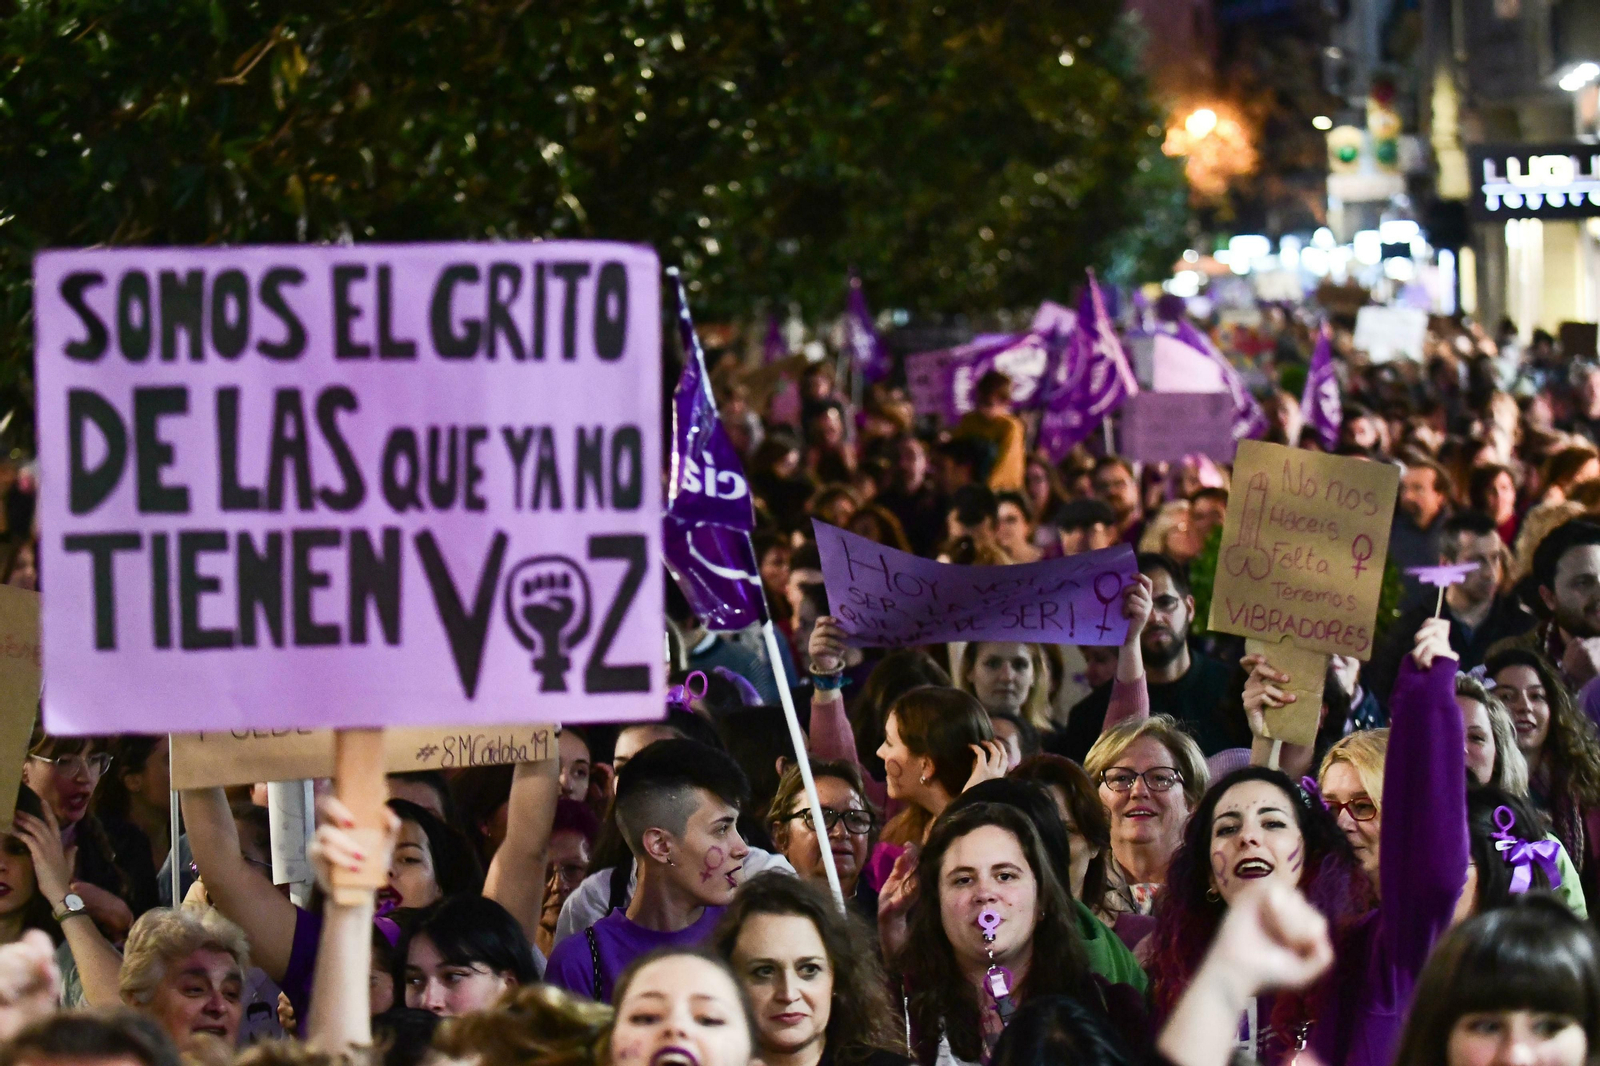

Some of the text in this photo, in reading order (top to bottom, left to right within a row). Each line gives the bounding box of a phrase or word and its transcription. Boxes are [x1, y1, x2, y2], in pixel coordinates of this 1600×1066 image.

[59, 260, 630, 364] SOMOS EL GRITO
[65, 384, 644, 516] DE LAS QUE YA NO
[1282, 458, 1318, 500] No
[62, 528, 402, 652] TIENEN
[839, 534, 939, 602] HOY
[1271, 580, 1357, 612] Tenemos
[1000, 600, 1076, 638] SER!
